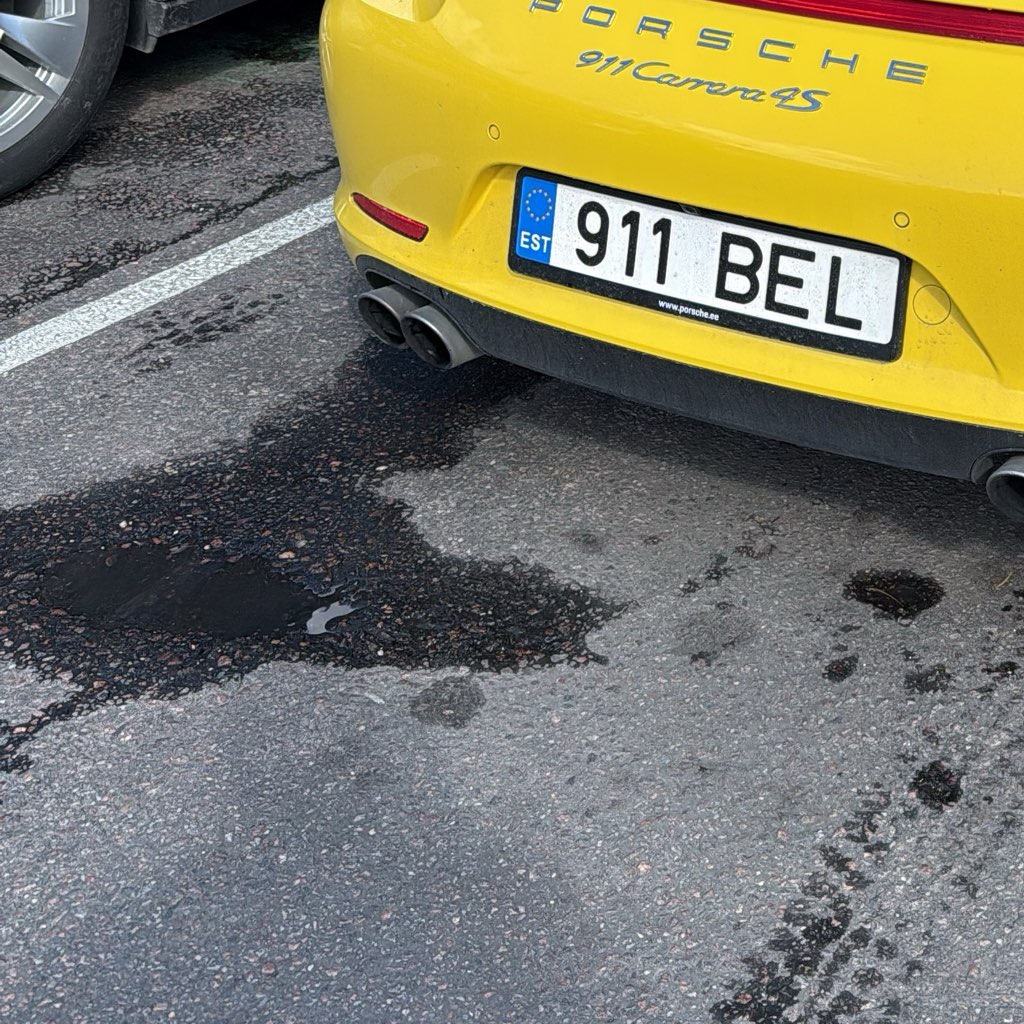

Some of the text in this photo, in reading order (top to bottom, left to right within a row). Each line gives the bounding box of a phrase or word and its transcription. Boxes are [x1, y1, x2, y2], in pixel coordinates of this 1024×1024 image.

[519, 230, 552, 254] EST
[575, 200, 863, 332] 911 BEL
[657, 299, 720, 322] www.porsche.ee
